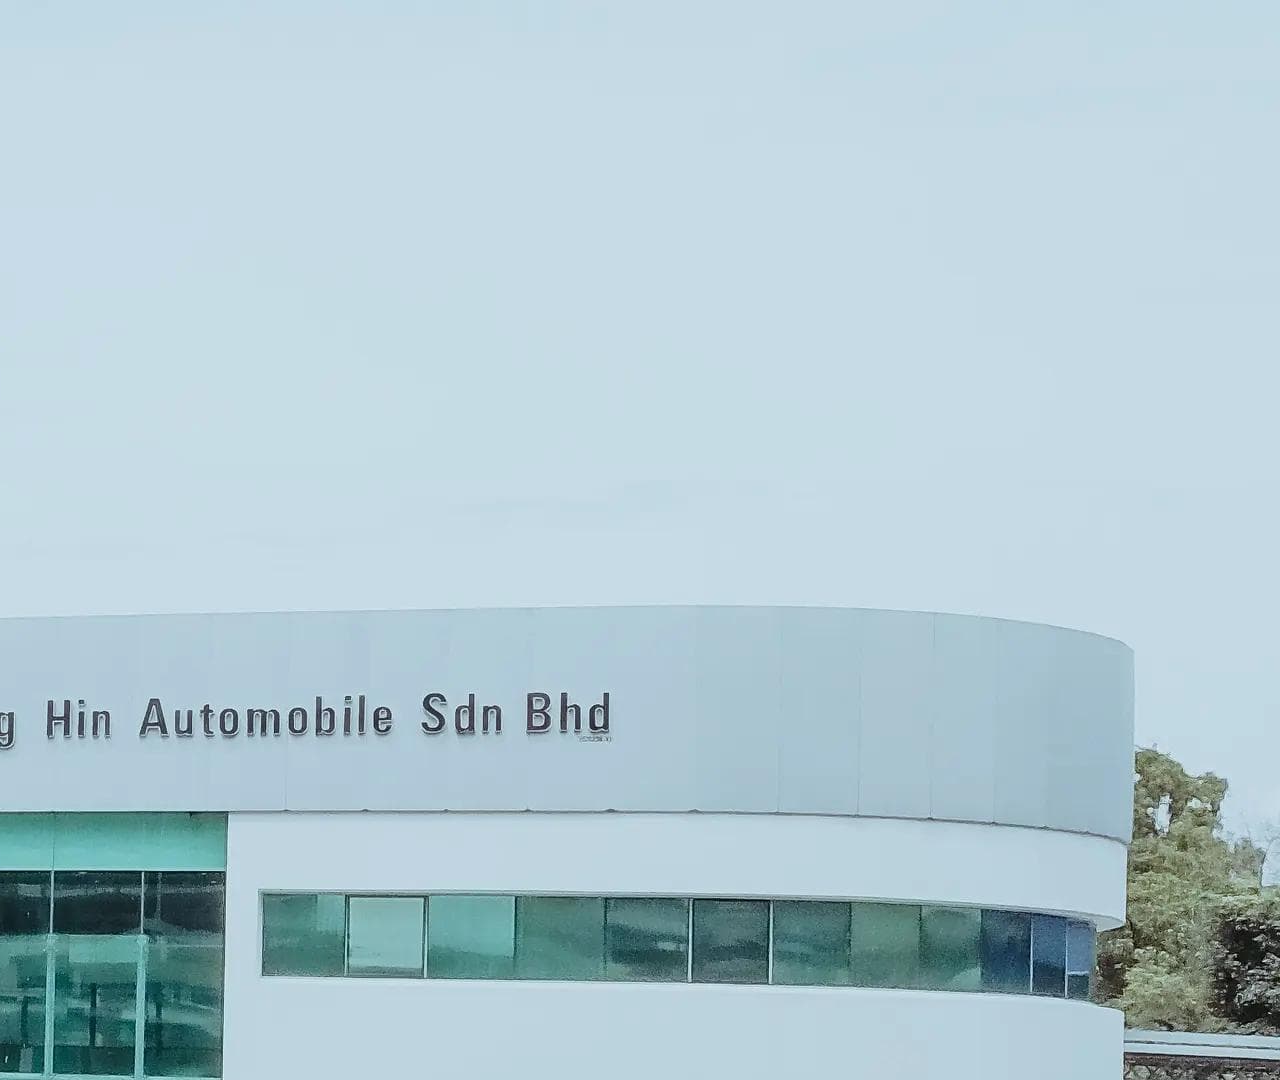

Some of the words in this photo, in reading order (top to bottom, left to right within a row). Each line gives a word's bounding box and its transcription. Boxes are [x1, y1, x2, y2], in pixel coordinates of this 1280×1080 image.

[46, 699, 113, 738] Hin
[139, 695, 393, 738] Automobile
[421, 692, 504, 735] Sdn
[526, 692, 611, 735] Bhd
